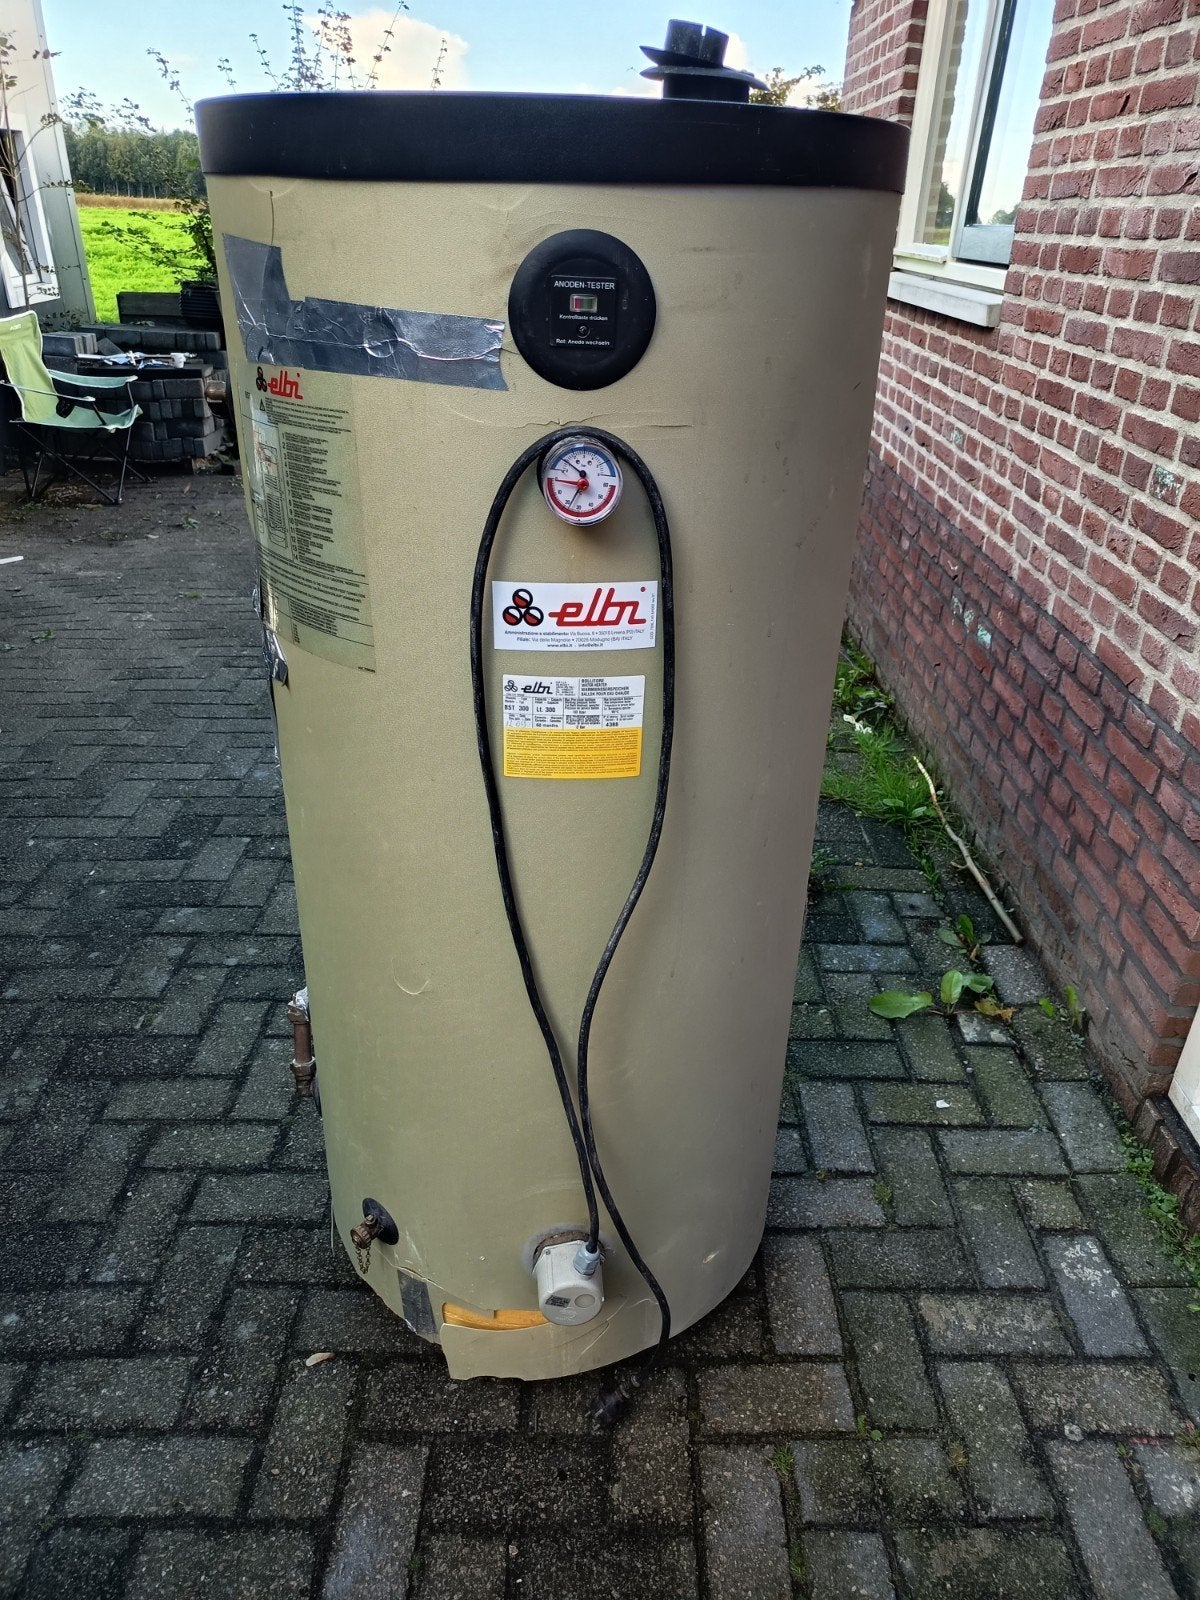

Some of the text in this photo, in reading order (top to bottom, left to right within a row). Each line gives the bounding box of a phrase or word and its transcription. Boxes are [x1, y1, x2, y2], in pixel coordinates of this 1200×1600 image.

[554, 280, 615, 290] ANODEN-TESTER
[267, 369, 304, 400] elbi
[548, 586, 647, 627] elbi
[521, 681, 554, 694] elbi
